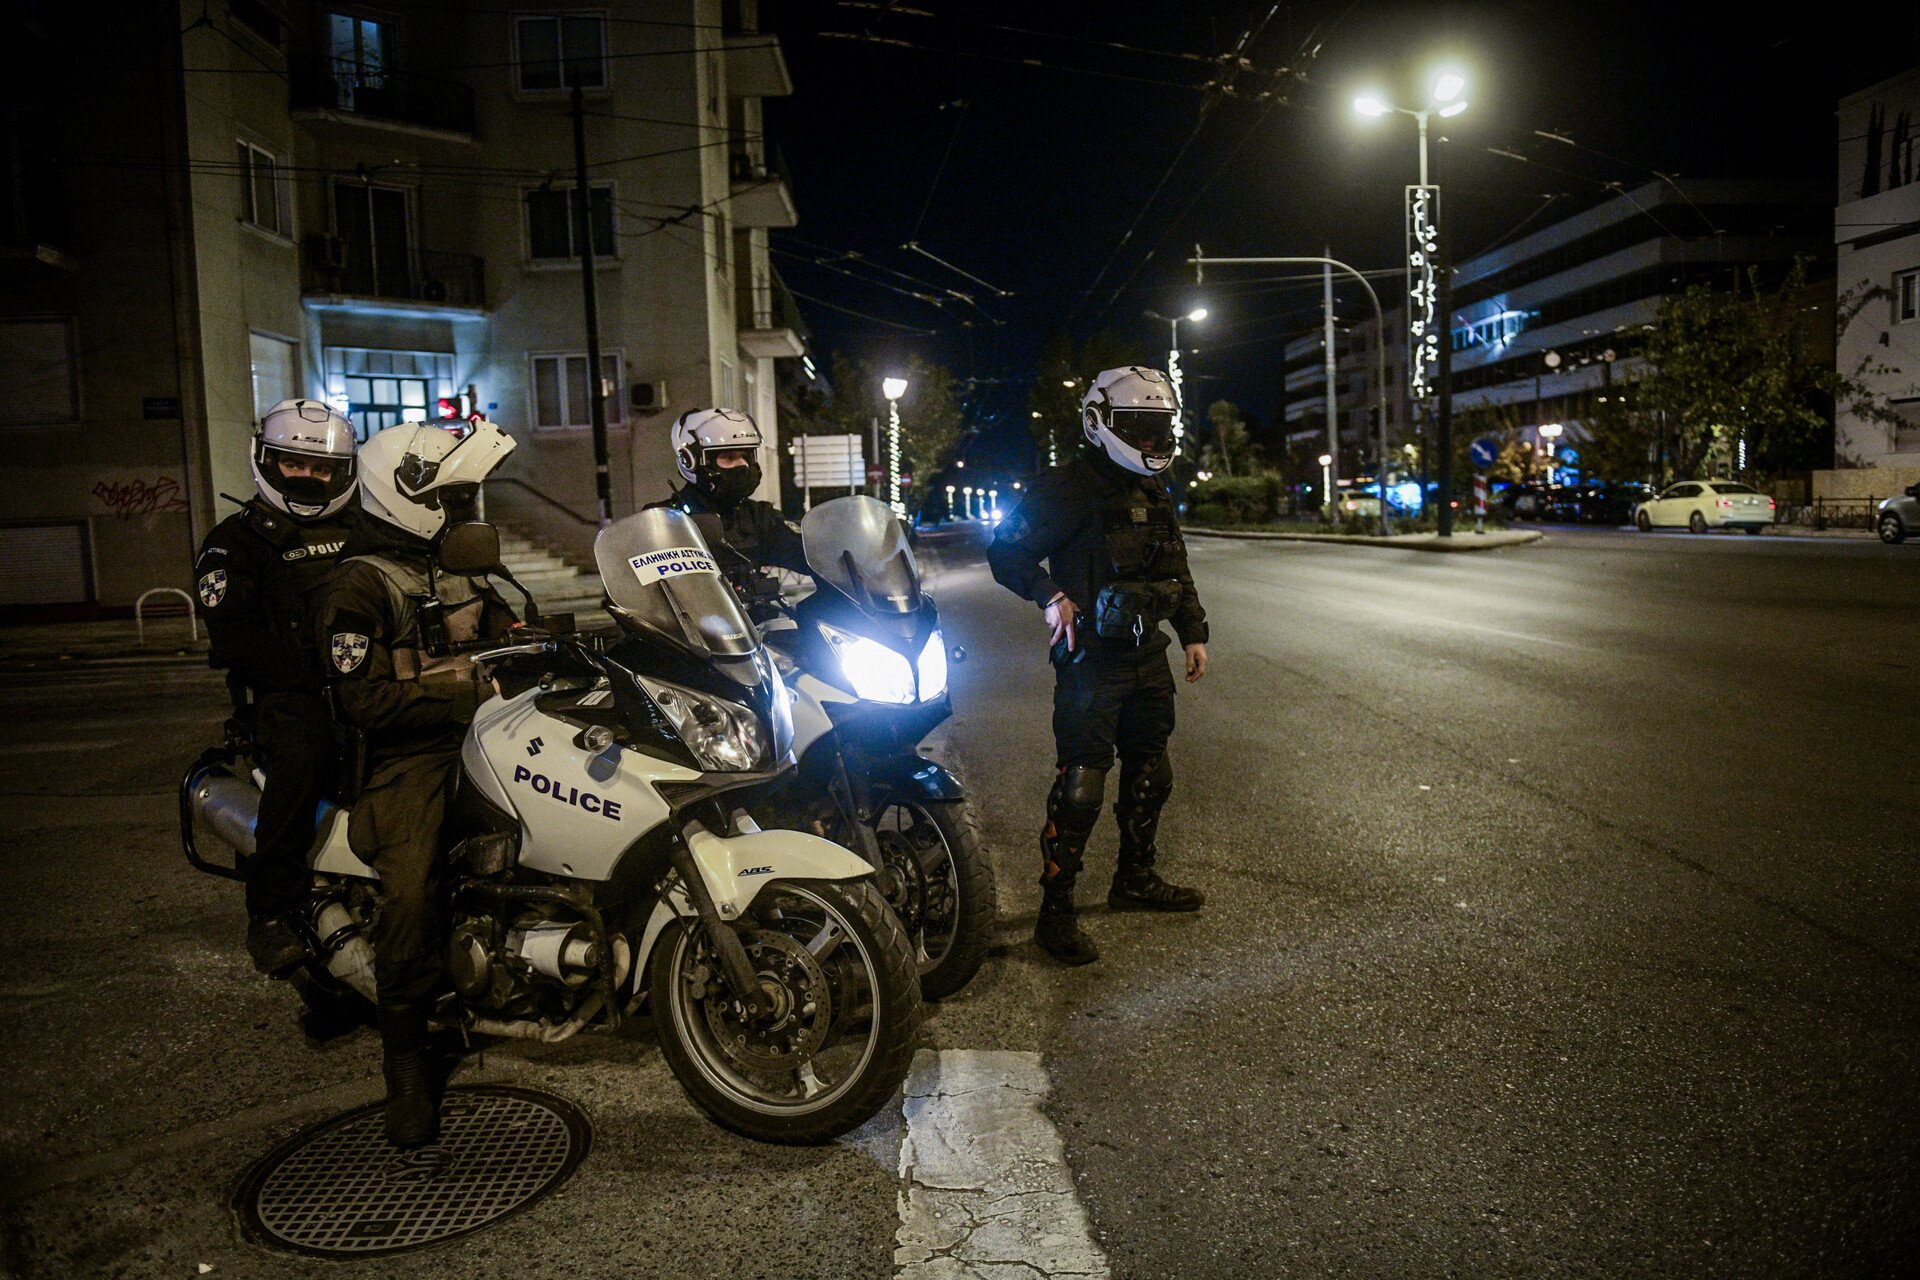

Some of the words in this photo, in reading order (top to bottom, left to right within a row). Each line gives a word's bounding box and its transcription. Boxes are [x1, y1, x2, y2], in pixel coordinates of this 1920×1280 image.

[632, 550, 681, 569] ΕΛΛΗΝΙΚΗ
[656, 560, 715, 576] POLICE
[513, 764, 622, 822] POLICE
[738, 865, 773, 877] ABS
